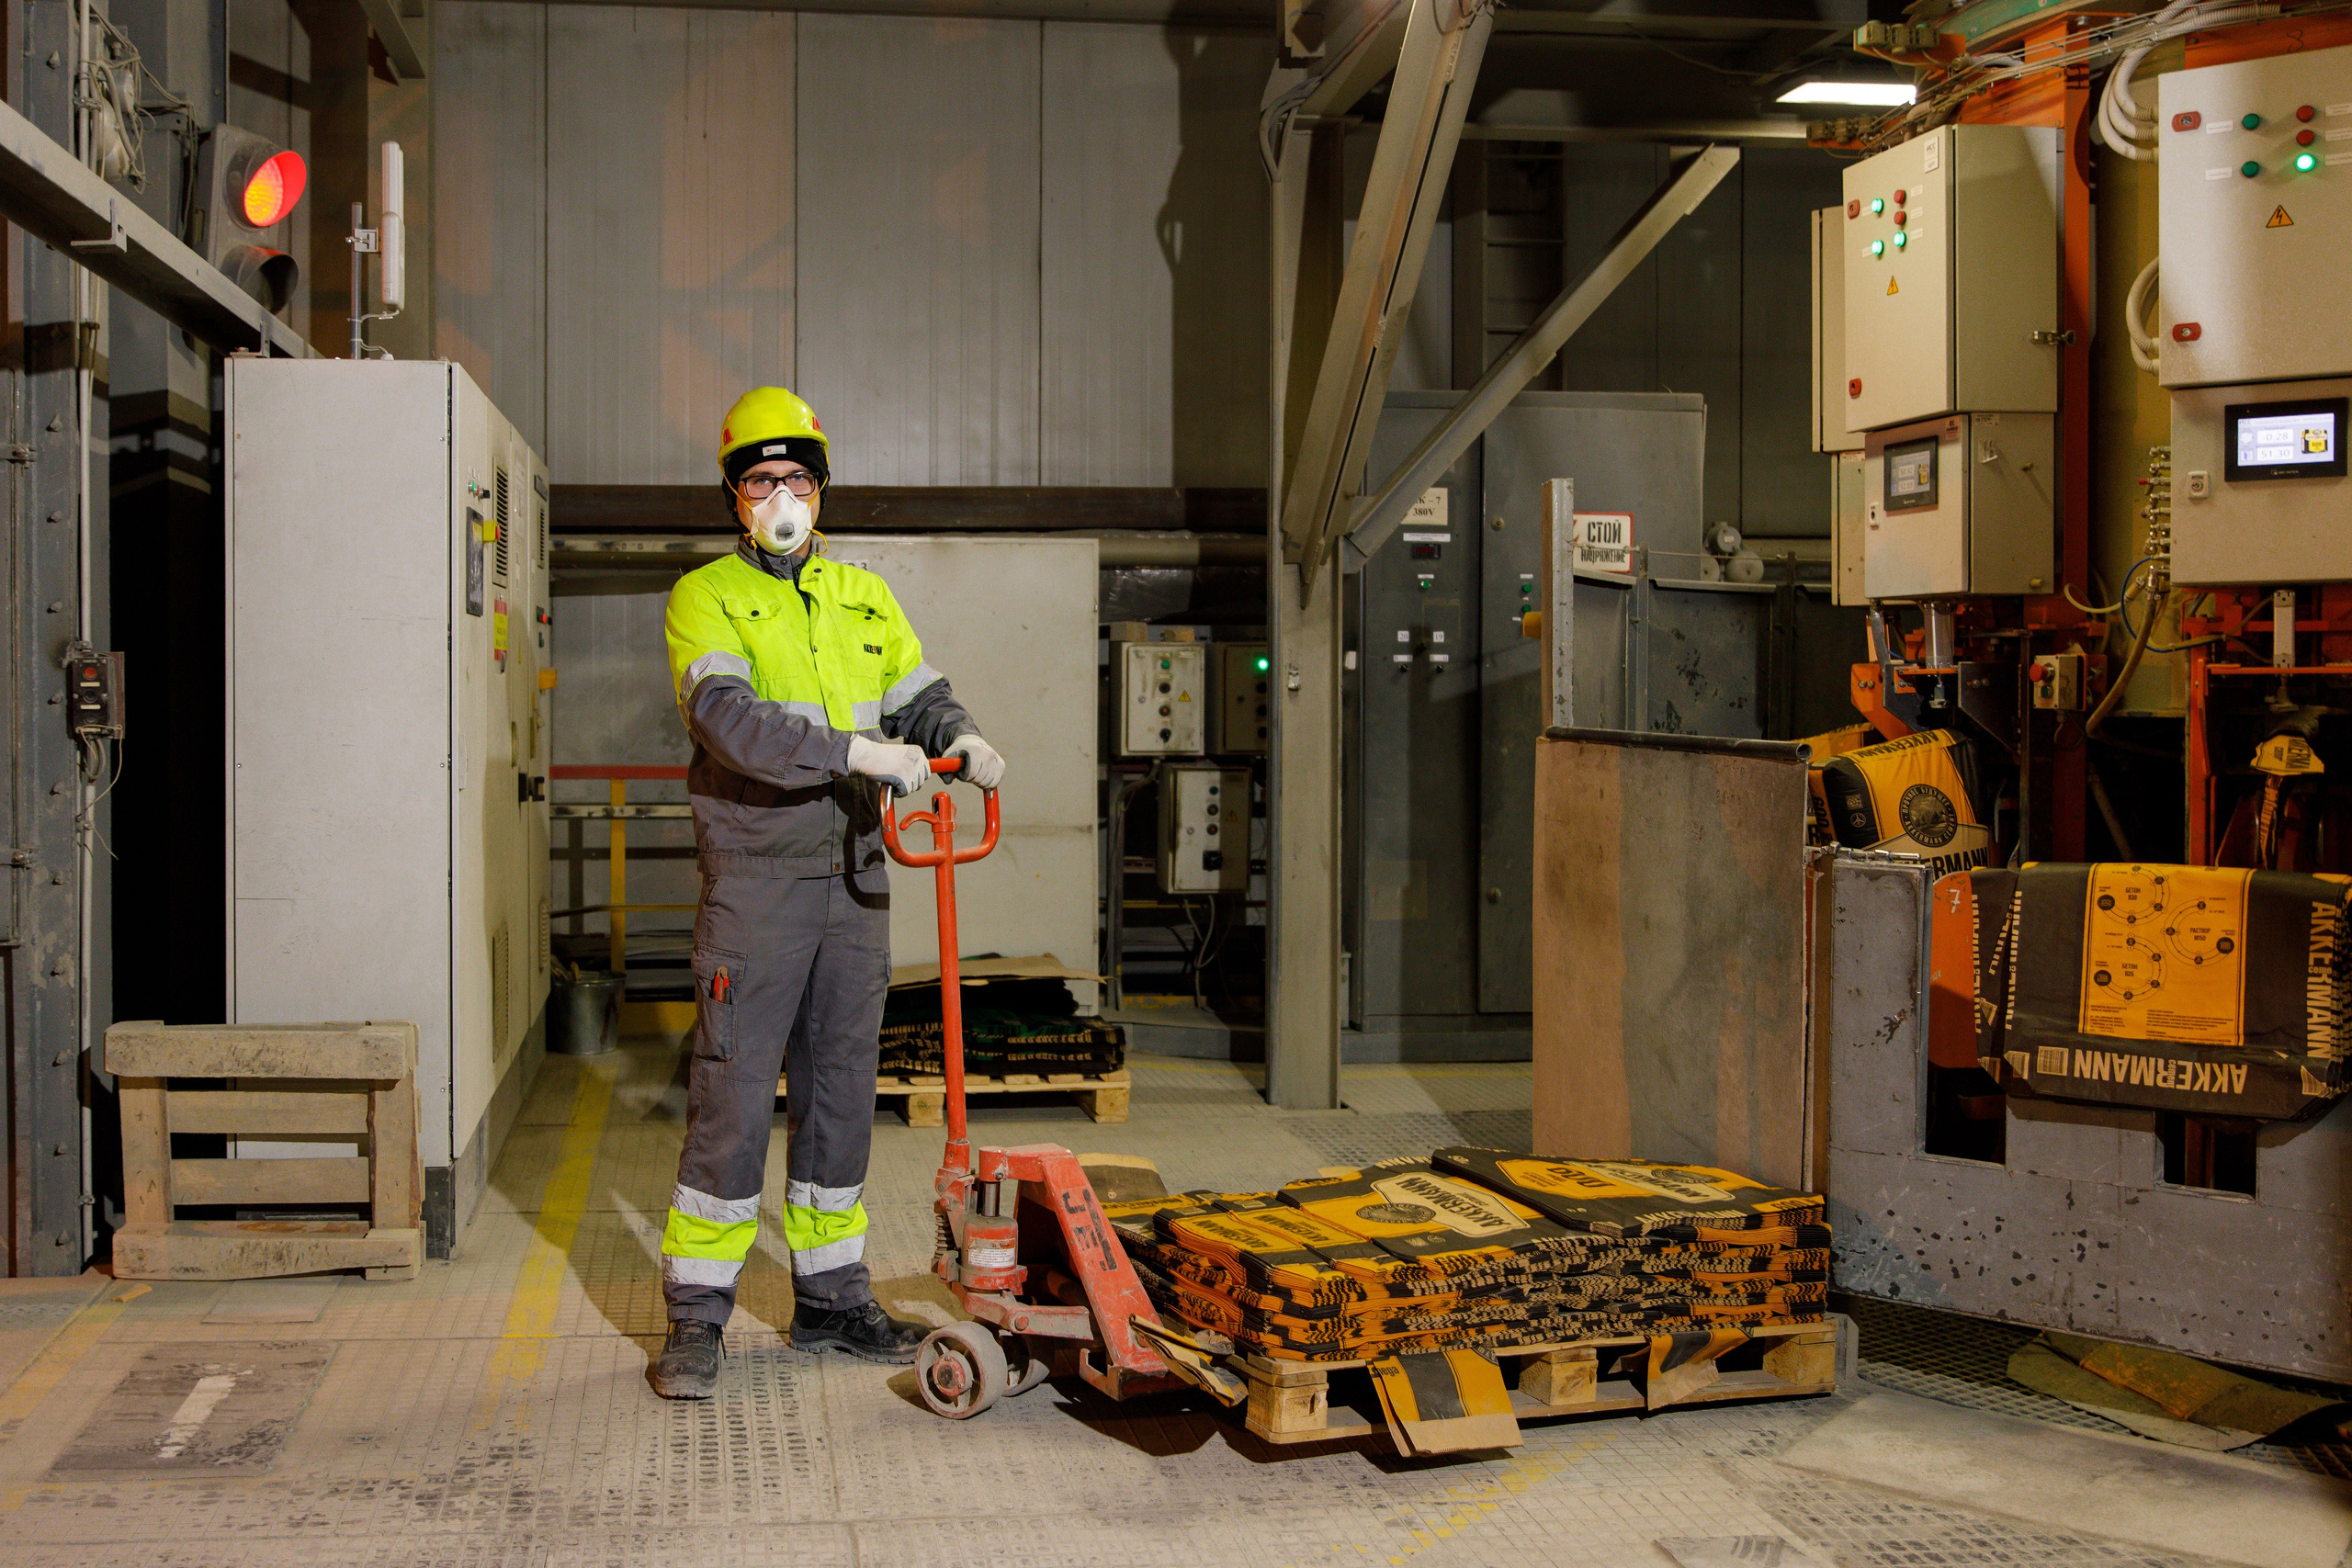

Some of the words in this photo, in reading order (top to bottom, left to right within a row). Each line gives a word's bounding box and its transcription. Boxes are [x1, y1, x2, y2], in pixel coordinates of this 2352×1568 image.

[2261, 449, 2290, 458] 51.30
[1413, 507, 1435, 516] 380V
[1588, 519, 1622, 544] СТОЙ
[1905, 820, 1943, 844] AKKERMANN
[1947, 888, 1961, 914] 7
[2307, 901, 2336, 1060] AKKERMANN
[2074, 1049, 2248, 1095] AKKERMANN
[1396, 1176, 1512, 1228] AKKERMANN
